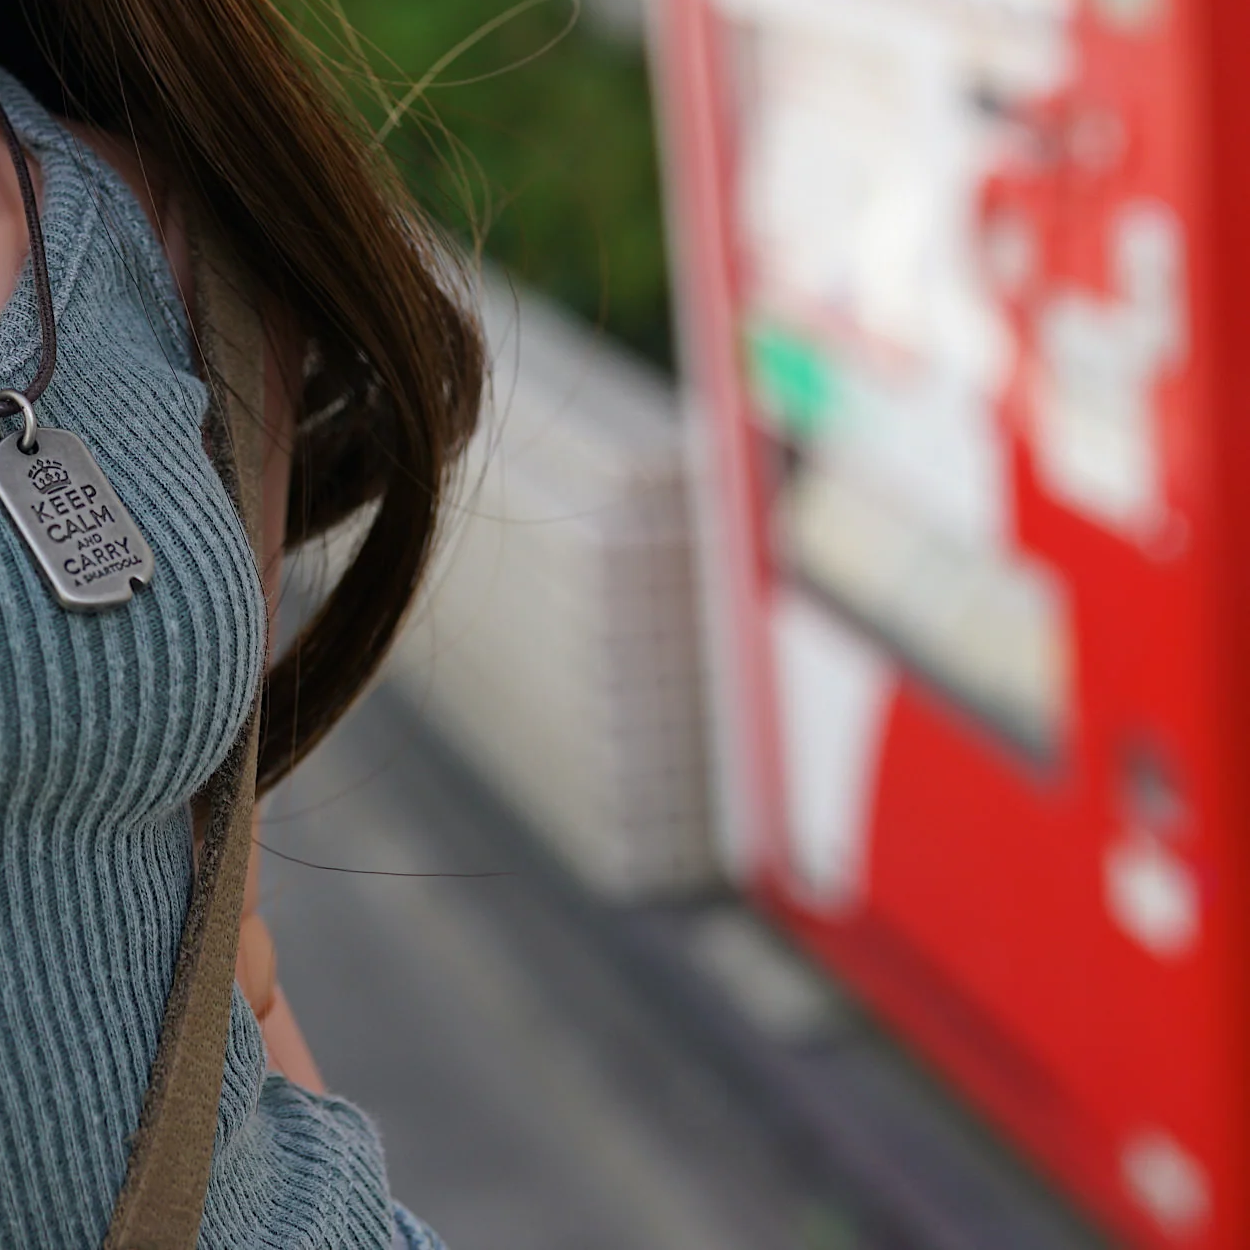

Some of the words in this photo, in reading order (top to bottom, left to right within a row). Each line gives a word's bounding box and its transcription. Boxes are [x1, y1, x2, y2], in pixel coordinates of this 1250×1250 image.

[31, 484, 97, 523] KEEP
[47, 505, 115, 543] CALM
[77, 533, 102, 551] AND
[64, 536, 130, 575] CARRY
